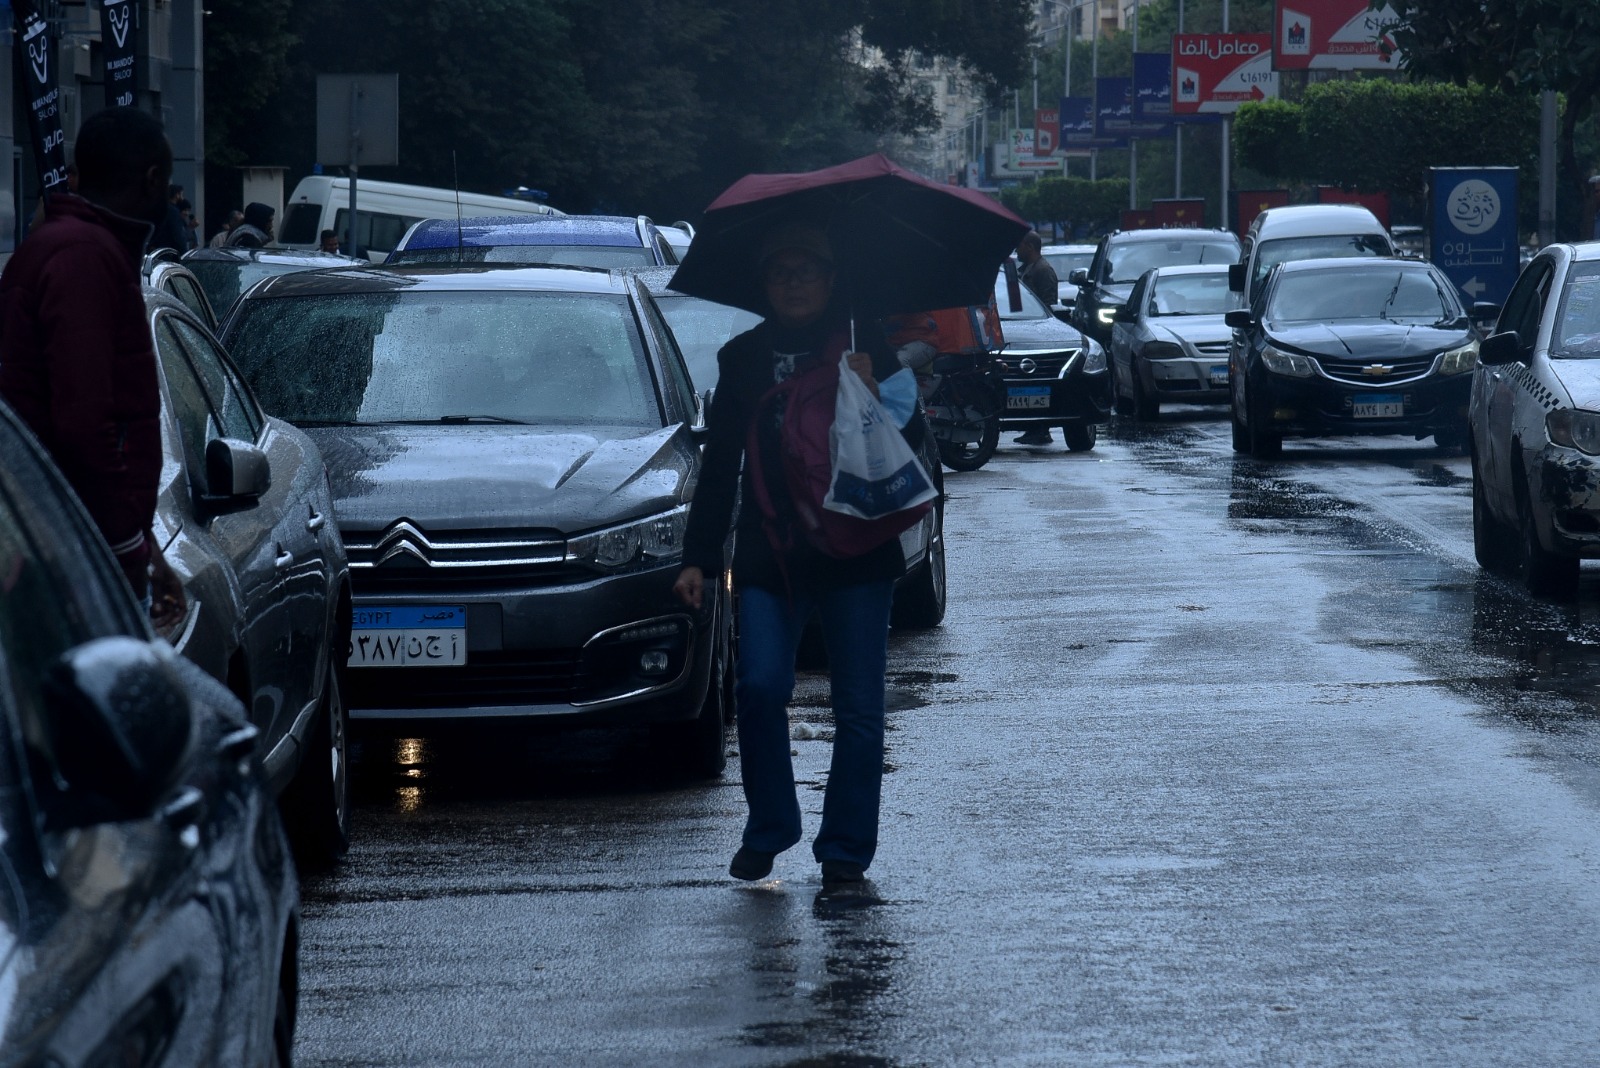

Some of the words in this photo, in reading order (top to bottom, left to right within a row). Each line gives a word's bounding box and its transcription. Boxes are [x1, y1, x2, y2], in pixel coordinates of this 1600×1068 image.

[1179, 40, 1208, 56] الفا
[1208, 41, 1259, 60] معامل
[1247, 72, 1272, 82] 16191
[351, 611, 392, 624] EGYPT
[417, 611, 454, 623] مصر
